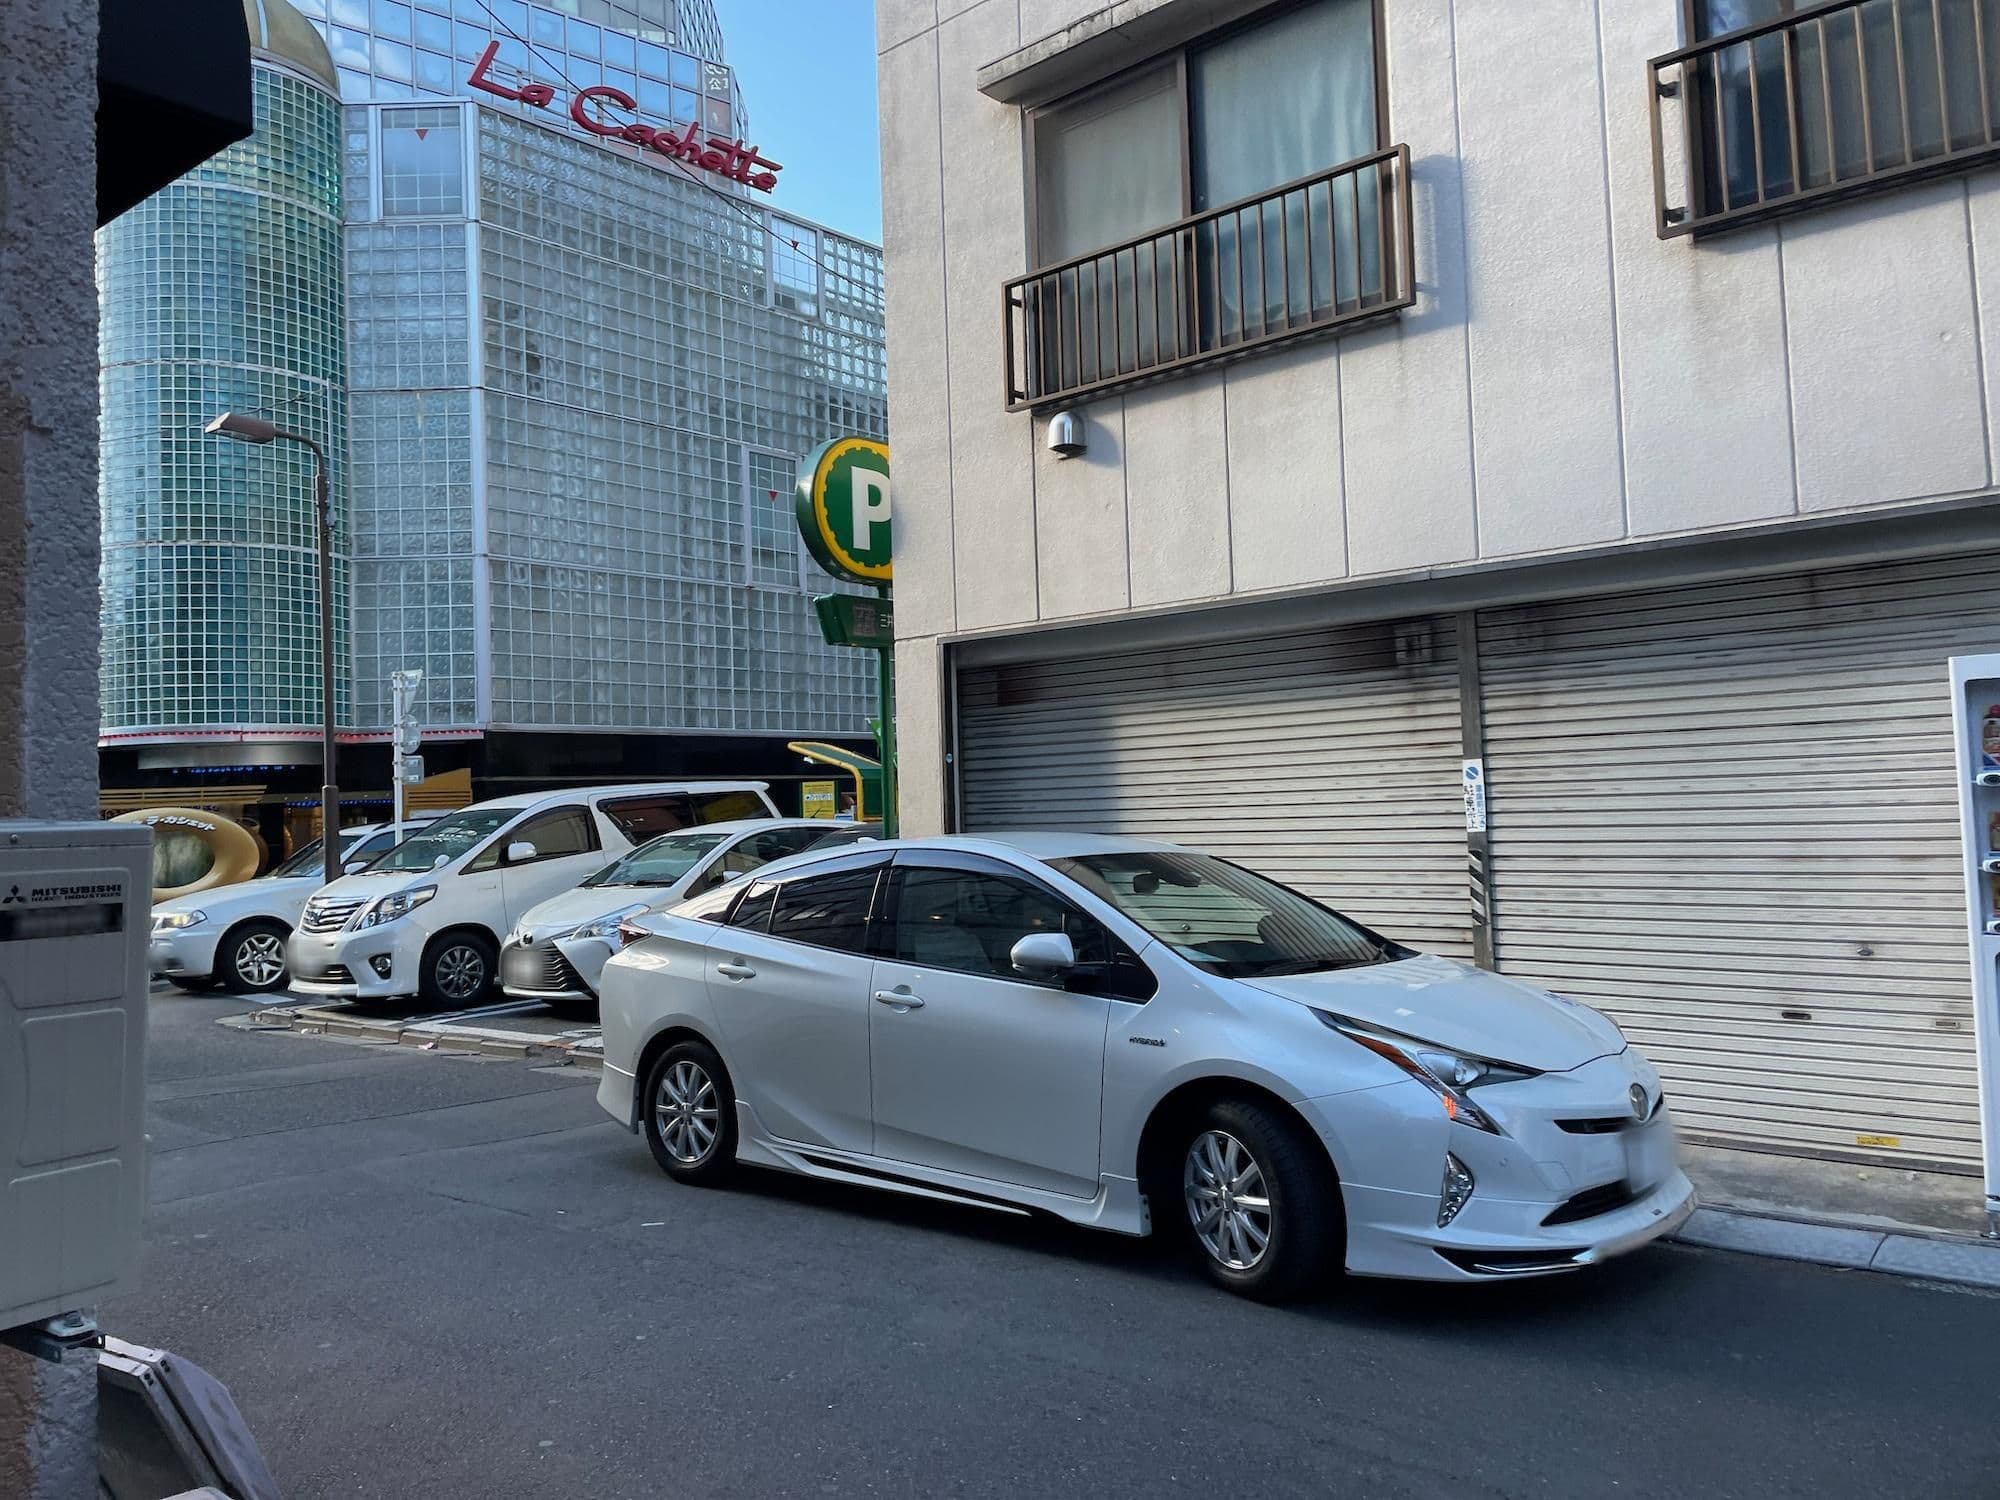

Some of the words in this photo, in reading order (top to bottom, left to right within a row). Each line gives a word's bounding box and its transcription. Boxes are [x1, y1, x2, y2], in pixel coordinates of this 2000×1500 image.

[467, 40, 556, 108] La
[570, 85, 784, 190] Cachette
[851, 465, 894, 551] P
[32, 884, 122, 897] MITSUBISHI
